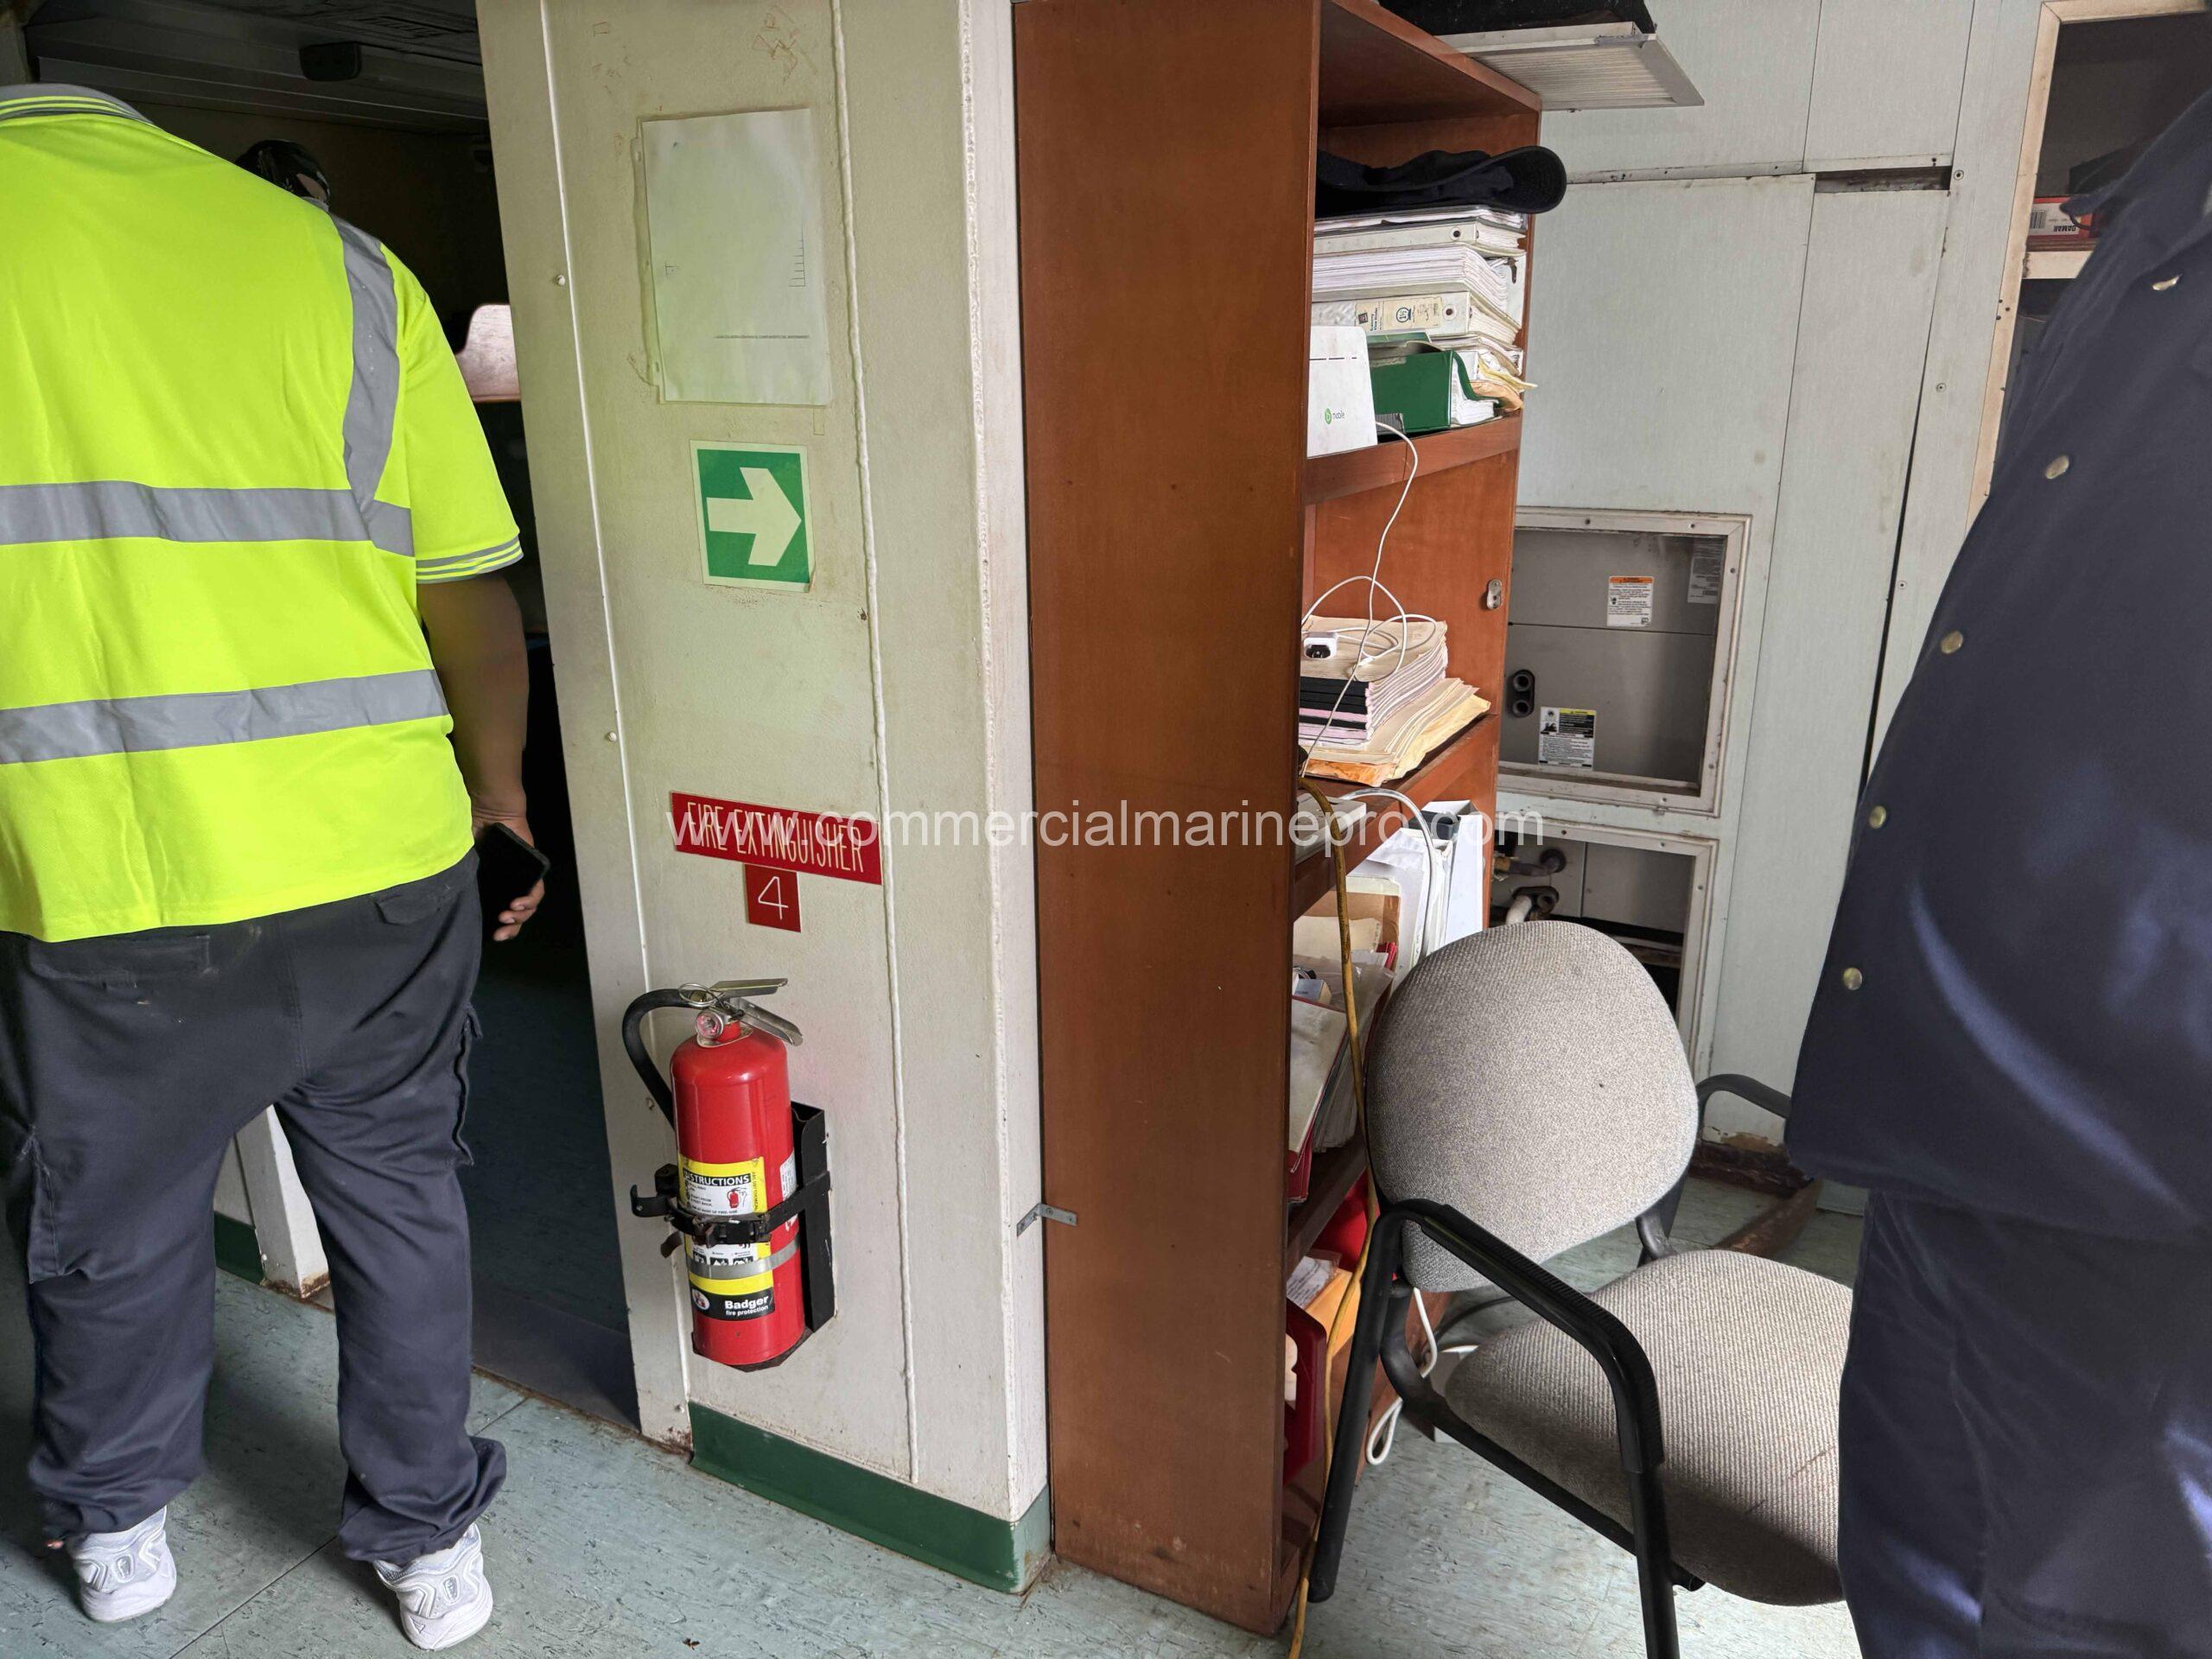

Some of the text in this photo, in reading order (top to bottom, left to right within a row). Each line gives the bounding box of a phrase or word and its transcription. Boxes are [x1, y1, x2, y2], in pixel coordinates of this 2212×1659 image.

[687, 802, 864, 873] FIRE EXTINGUISHER
[758, 875, 789, 919] 4
[683, 1170, 750, 1186] INSTRUCTIONS
[724, 1295, 769, 1310] Badger
[737, 1305, 769, 1317] protection
